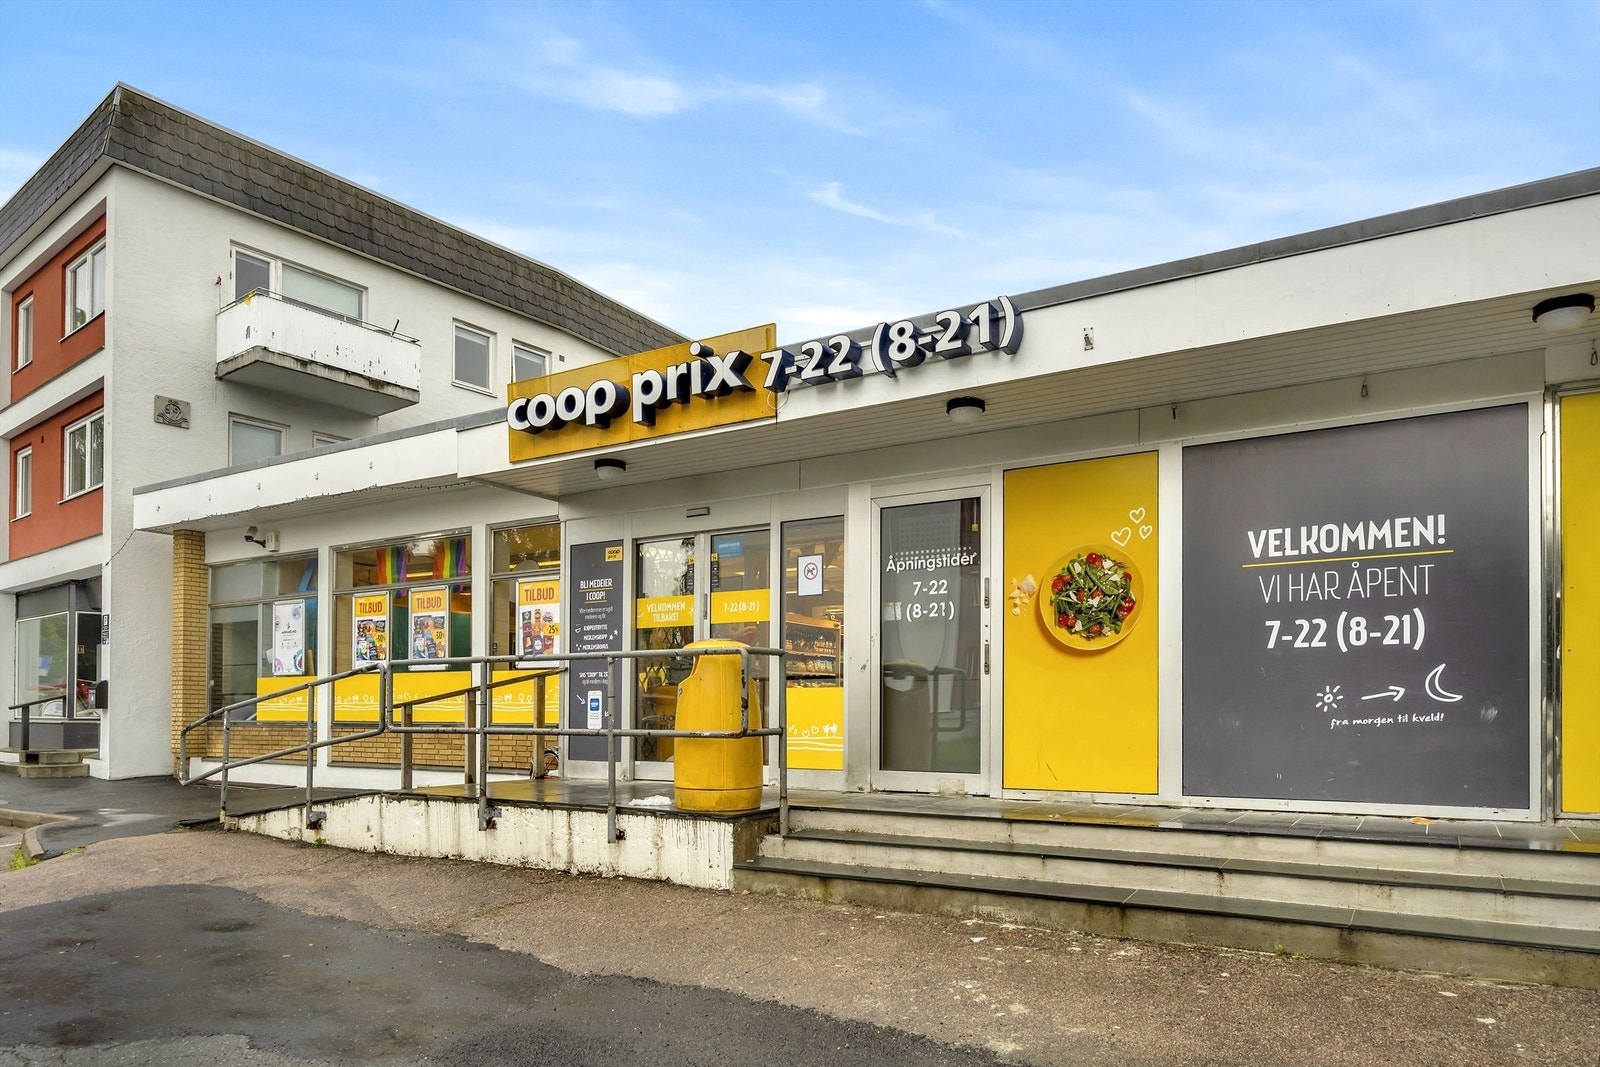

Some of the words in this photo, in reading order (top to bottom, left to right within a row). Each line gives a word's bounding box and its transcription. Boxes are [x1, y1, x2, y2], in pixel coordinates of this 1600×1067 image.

[760, 335, 861, 390] 7-22
[871, 295, 1022, 375] (8-21)
[506, 378, 625, 433] coop
[632, 341, 753, 425] prix
[1247, 514, 1446, 559] VELKOMMEN!
[885, 552, 977, 574] Åpningstider
[580, 580, 589, 589] BLI
[912, 579, 948, 596] 7-22
[1258, 574, 1280, 603] VI
[1288, 570, 1342, 602] HAR
[1347, 561, 1435, 600] ÅPENT
[416, 596, 442, 609] TILBUD
[524, 587, 555, 602] TILBUD
[359, 601, 383, 614] TILBUD
[646, 601, 686, 613] VELKOMMEN
[723, 602, 738, 612] 7-22
[906, 601, 955, 622] (8-21)
[1265, 618, 1327, 649] 7-22
[1336, 607, 1426, 653] (8-21)
[1330, 718, 1349, 730] fra
[1352, 717, 1394, 727] morgen
[1397, 714, 1408, 723] til
[1412, 712, 1445, 722] kveld!
